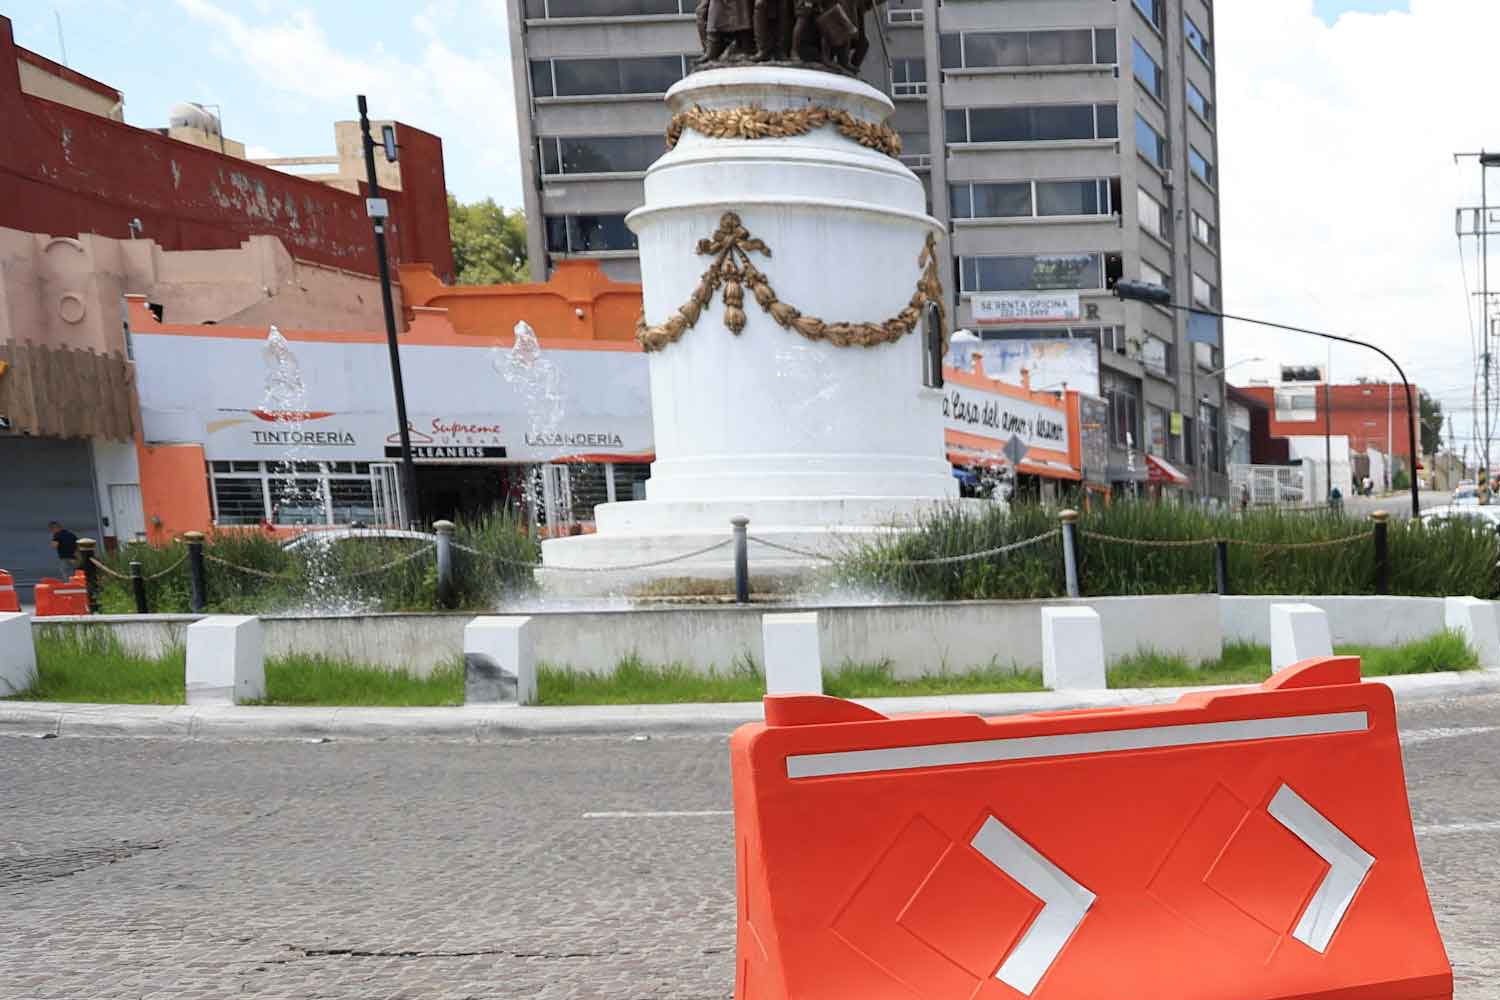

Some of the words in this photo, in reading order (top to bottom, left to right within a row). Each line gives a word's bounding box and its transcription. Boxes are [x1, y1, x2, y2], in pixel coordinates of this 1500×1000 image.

[995, 299, 1027, 311] RENTA
[1029, 297, 1068, 309] OFICINA
[952, 389, 979, 423] Casa
[982, 400, 1000, 429] del
[1002, 410, 1026, 435] amor
[431, 417, 502, 437] Supreme
